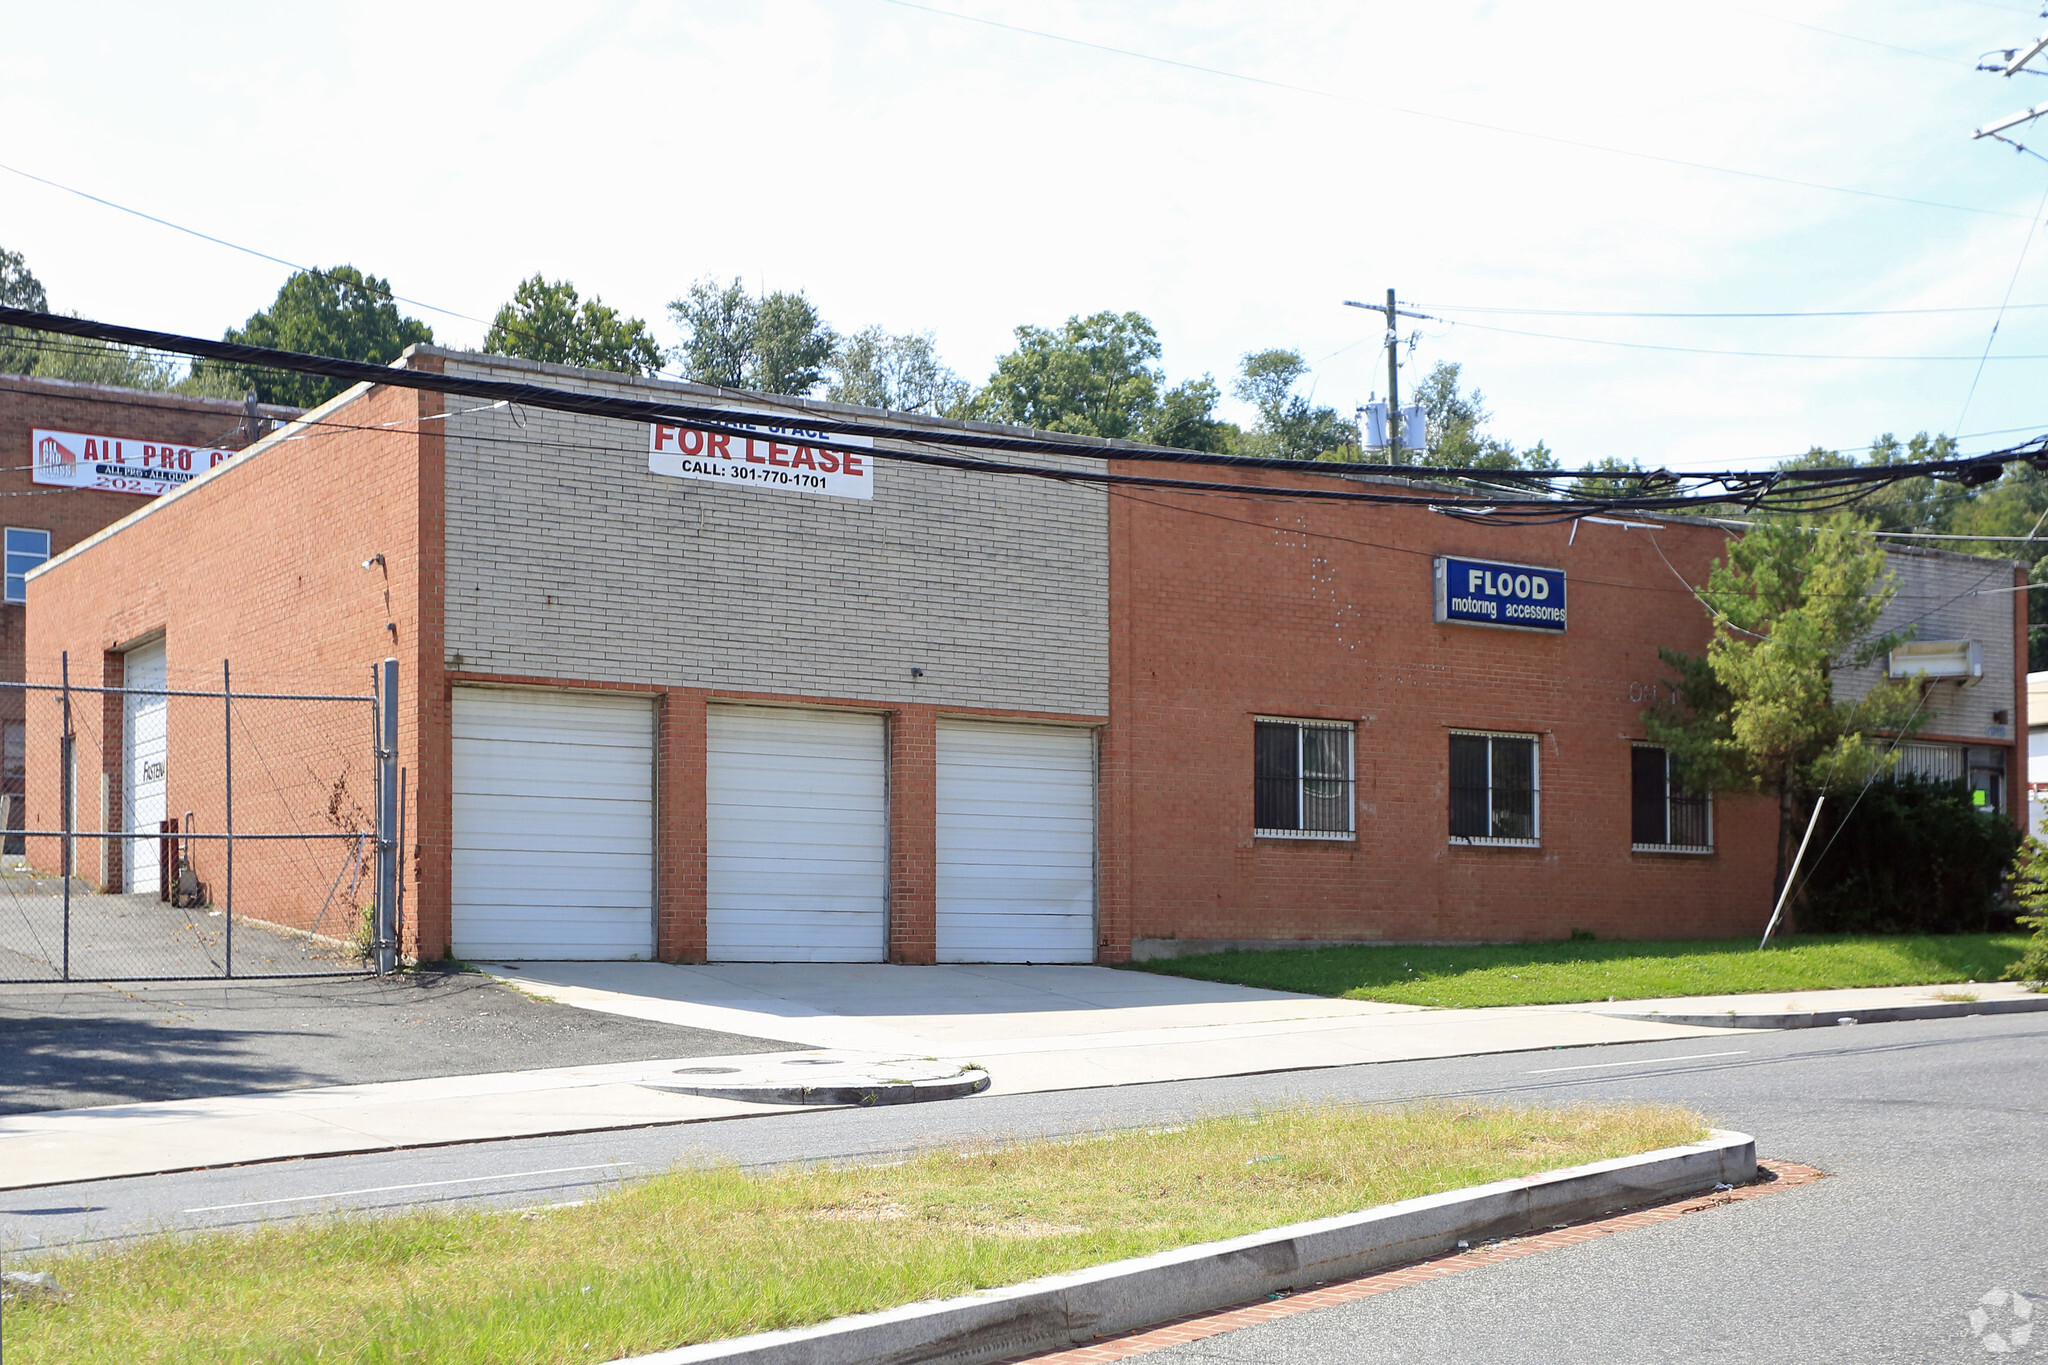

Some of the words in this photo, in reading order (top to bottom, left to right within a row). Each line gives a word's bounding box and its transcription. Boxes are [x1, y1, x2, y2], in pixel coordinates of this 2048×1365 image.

[84, 438, 125, 465] ALL
[143, 444, 191, 471] PRO
[655, 424, 732, 461] FOR
[746, 437, 864, 477] LEASE
[682, 459, 726, 477] CALL:
[731, 465, 827, 489] 301-770-1701
[1468, 569, 1549, 600] FLOOD
[1452, 596, 1497, 619] motoring
[1506, 602, 1566, 622] accessories
